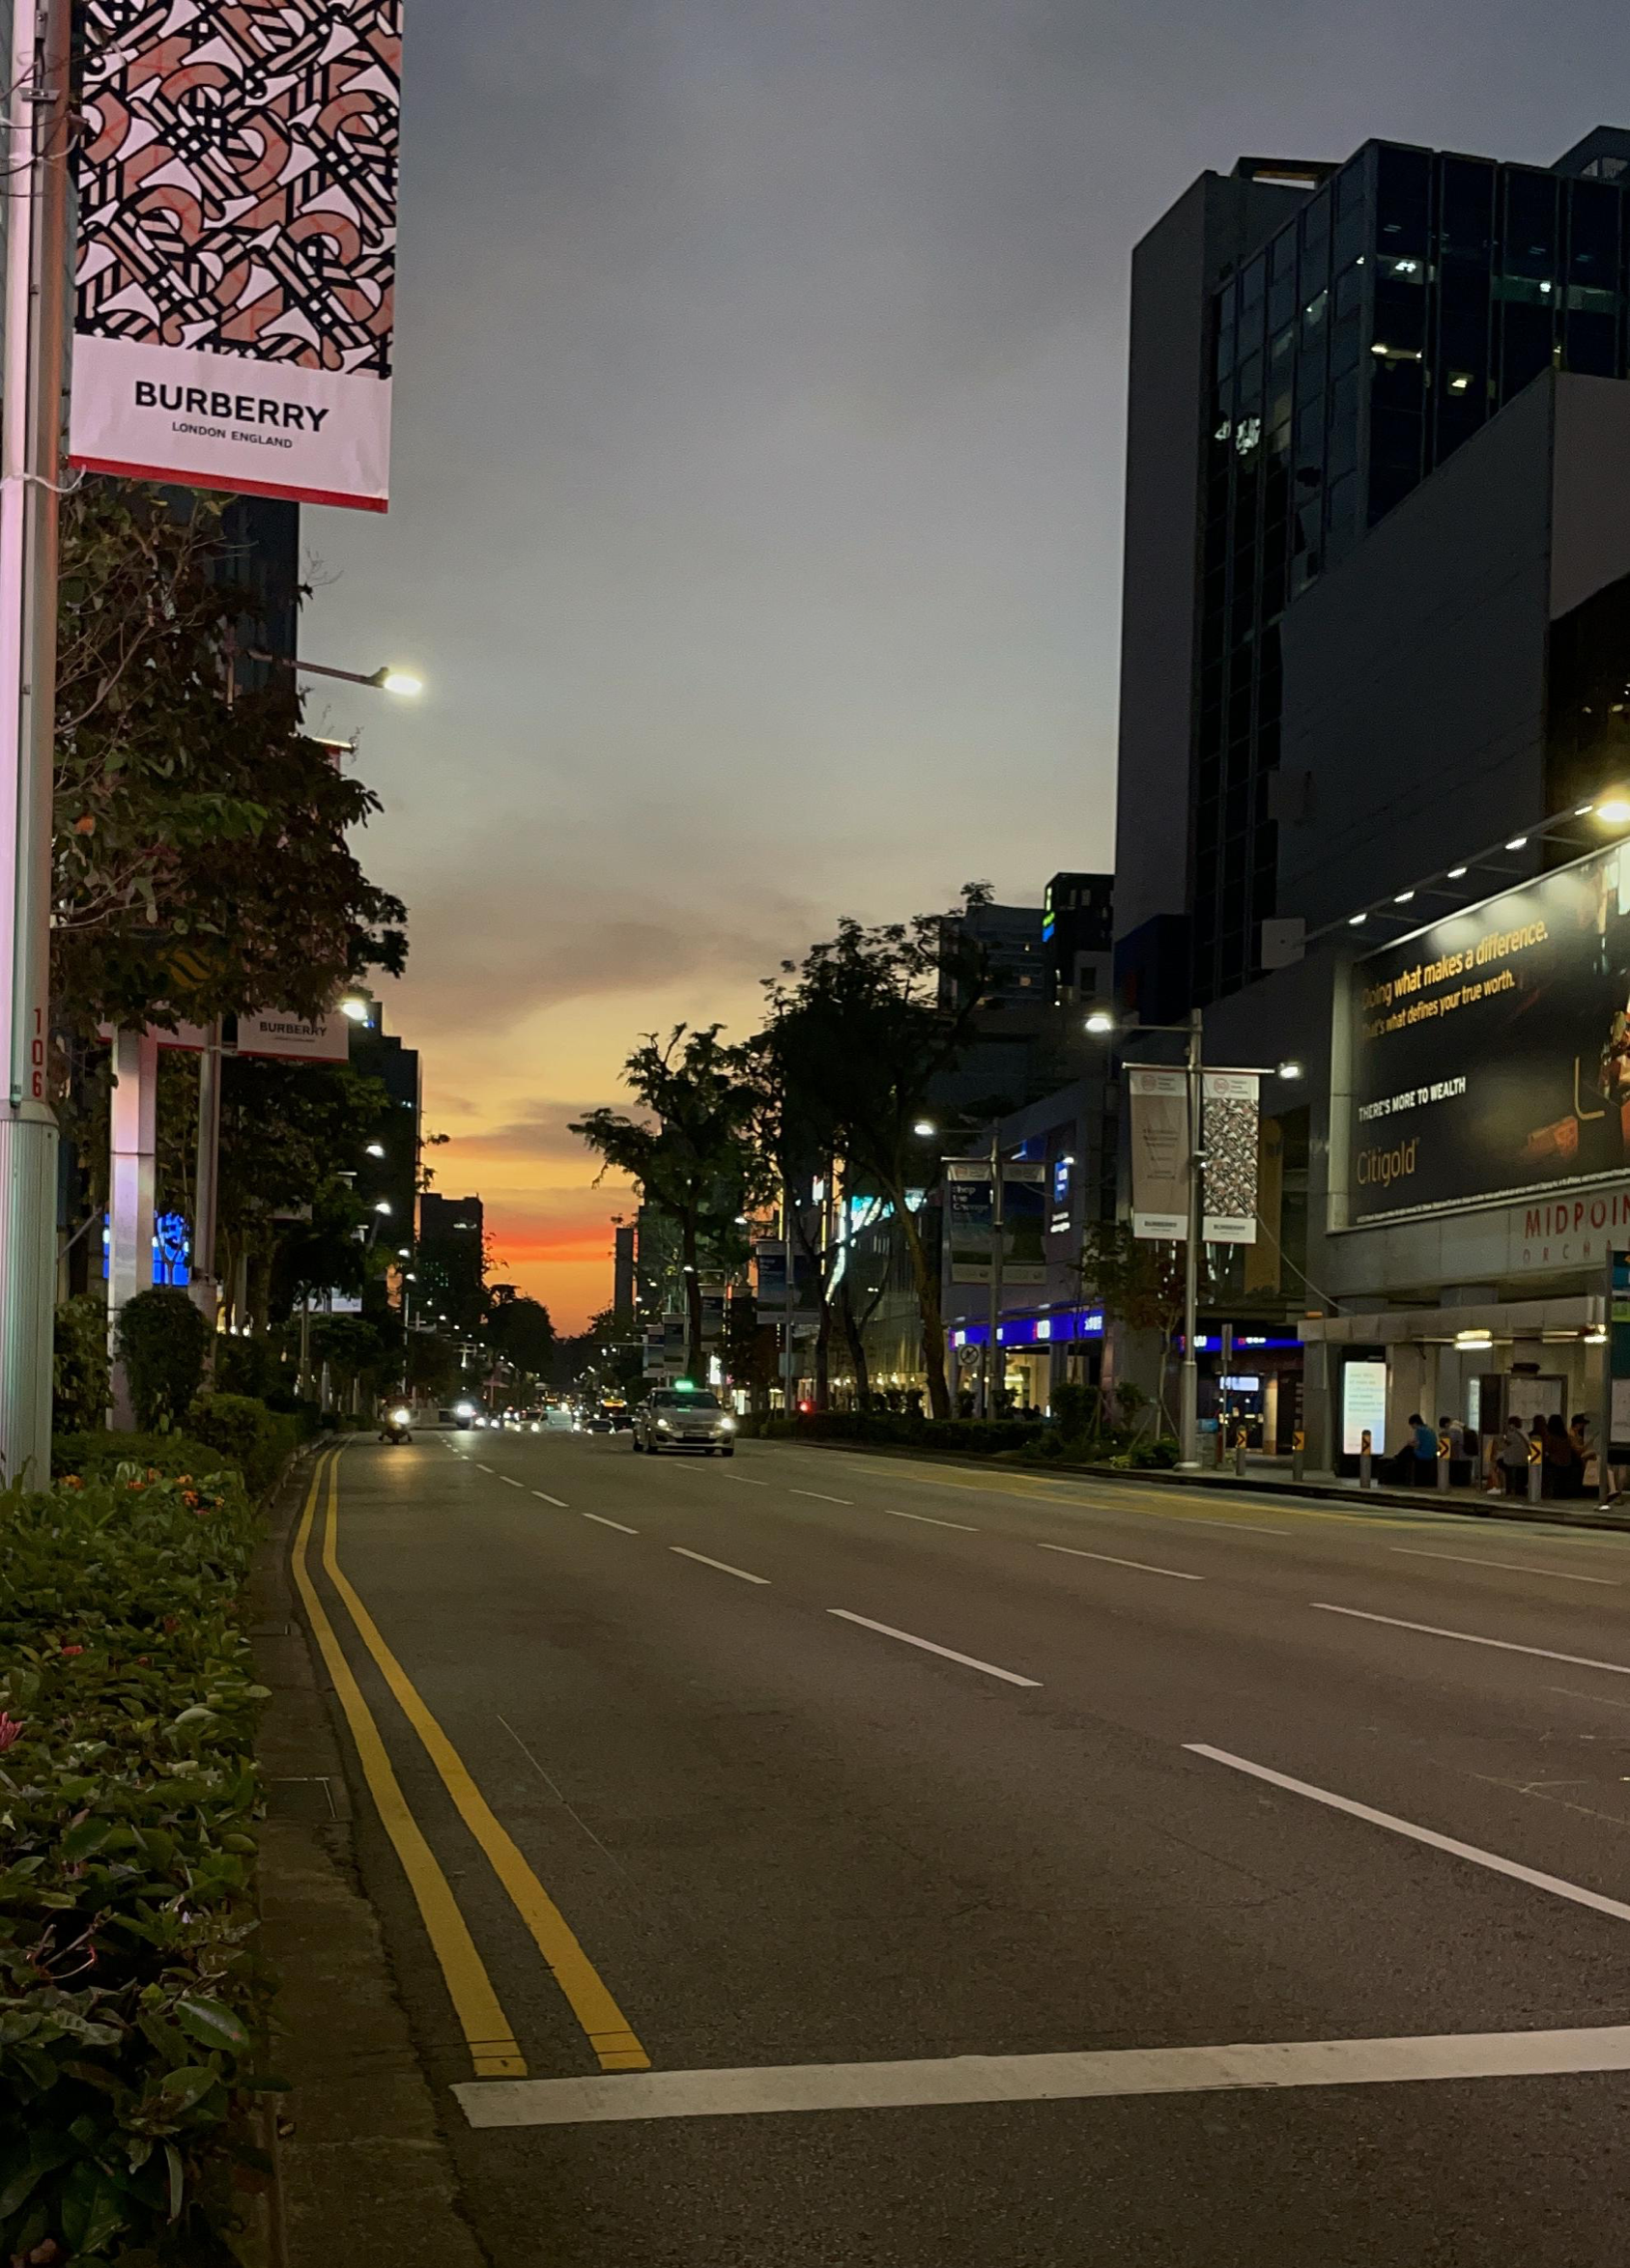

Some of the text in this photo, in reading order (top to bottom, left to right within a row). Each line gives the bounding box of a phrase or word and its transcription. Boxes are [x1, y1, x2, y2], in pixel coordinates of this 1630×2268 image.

[134, 381, 329, 434] BURBERRY
[171, 421, 294, 450] LONDON ENGLAND
[1394, 964, 1421, 998] what
[1424, 952, 1463, 986] makes
[1465, 949, 1473, 970] a
[1476, 920, 1548, 965] difference.
[1386, 1008, 1406, 1033] what
[1407, 998, 1438, 1025] defines
[1439, 991, 1461, 1017] your
[1462, 984, 1482, 1005] true
[1483, 968, 1515, 996] worth.
[32, 1007, 43, 1097] 106
[259, 1021, 328, 1037] BURBERRY
[1358, 1076, 1466, 1122] THERE'S MORE TO WEALTH
[1357, 1138, 1416, 1187] Citigold
[1523, 1235, 1630, 1264] ORCHA
